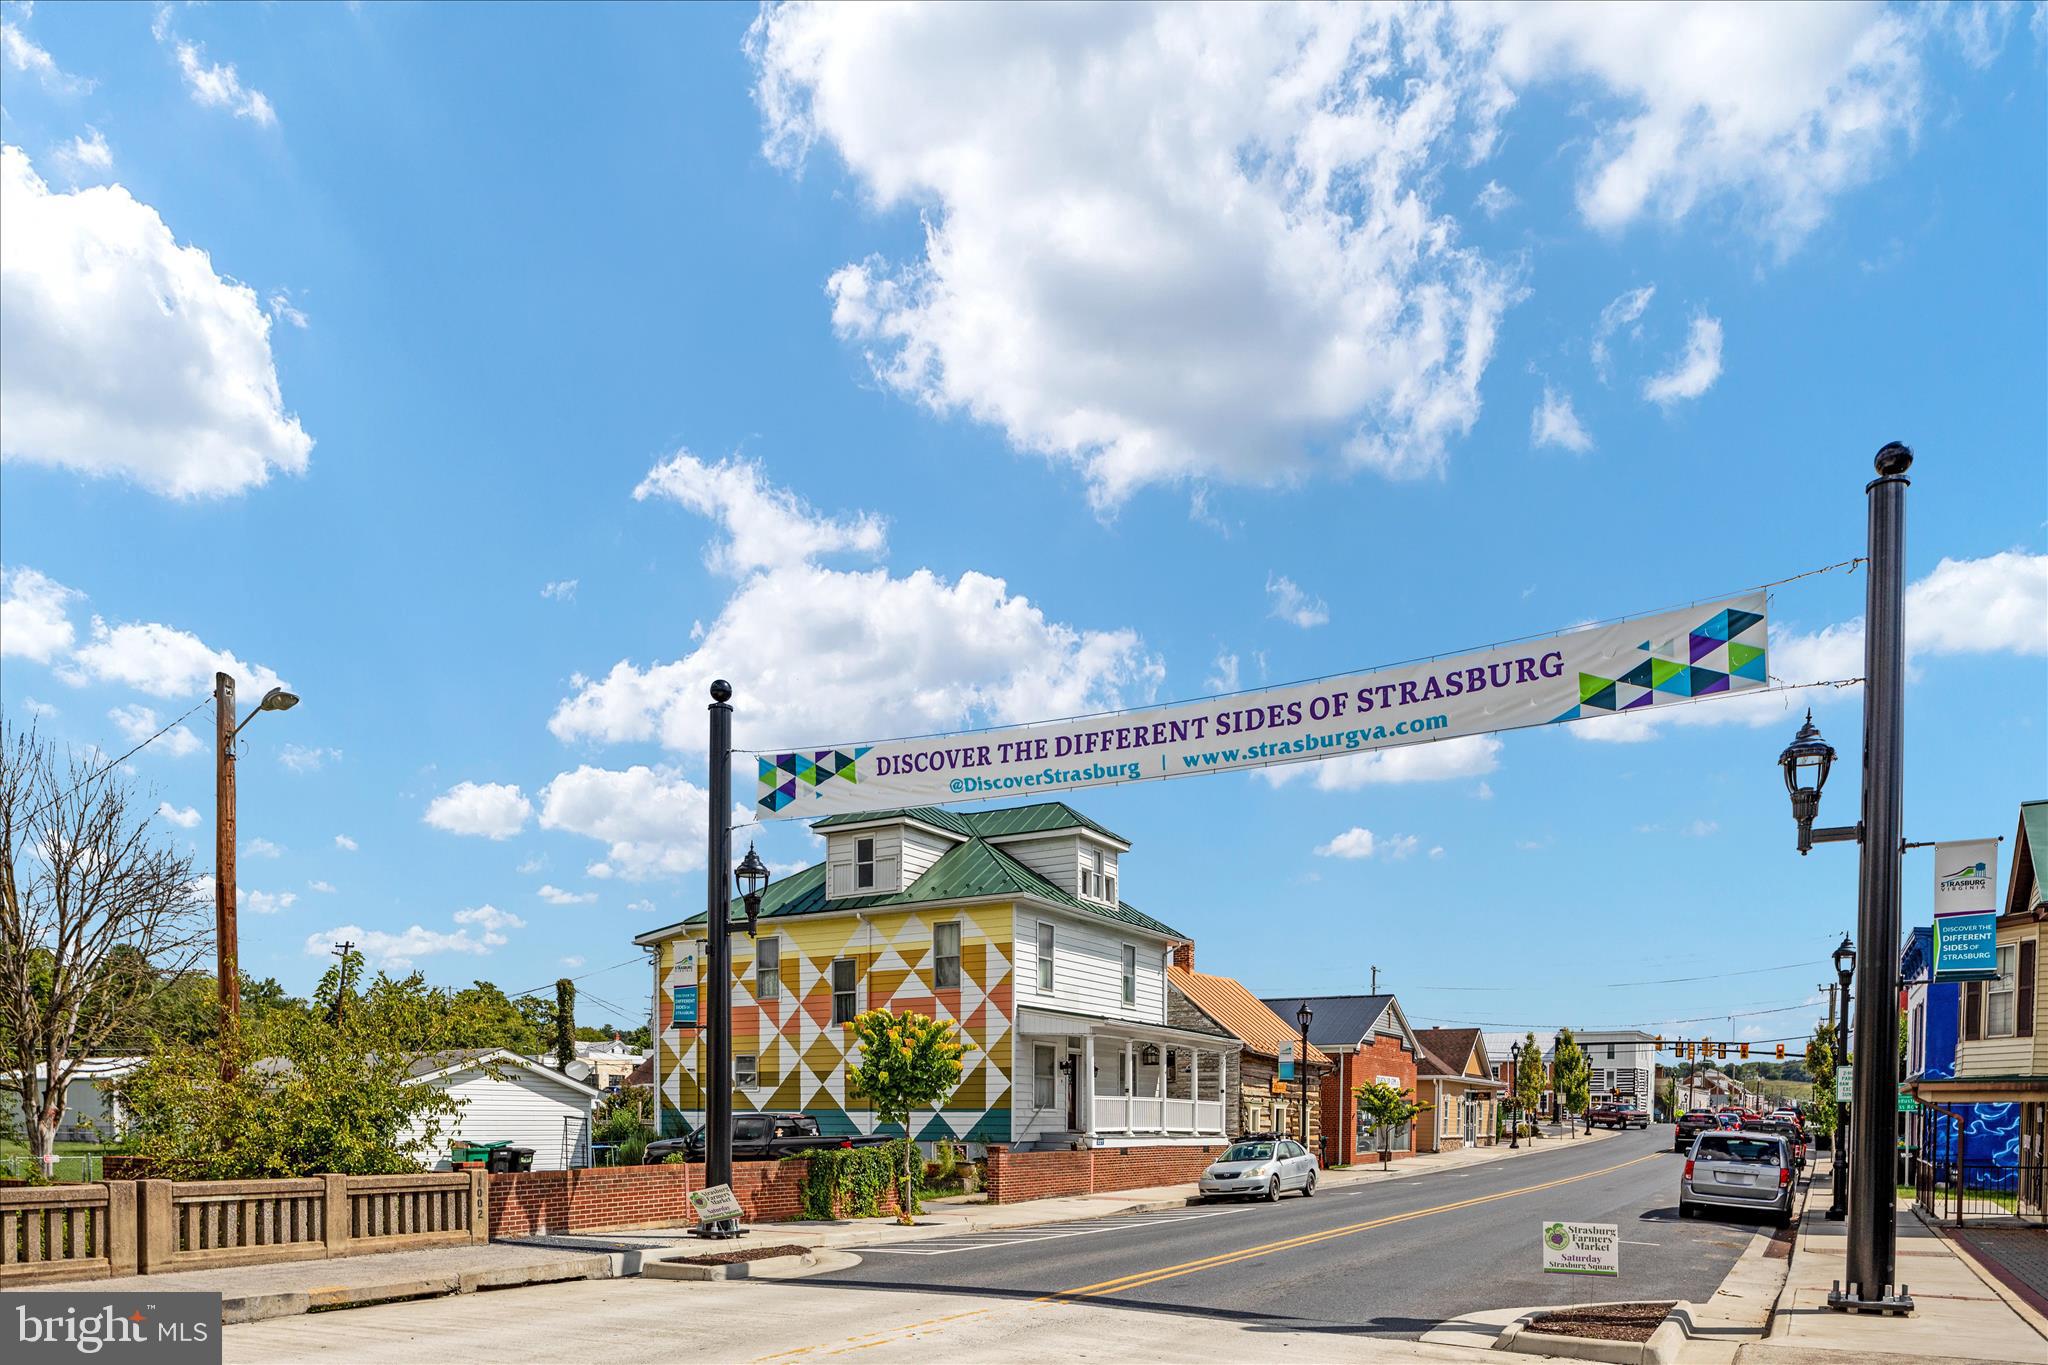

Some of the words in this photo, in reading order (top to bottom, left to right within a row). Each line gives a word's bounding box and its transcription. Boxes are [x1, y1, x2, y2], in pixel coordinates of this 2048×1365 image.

[877, 747, 992, 777] DISCOVER
[999, 741, 1049, 765] THE
[1056, 717, 1210, 758] DIFFERENT
[1216, 703, 1303, 737] SIDES
[1310, 693, 1350, 722] OF
[1358, 651, 1566, 714] STRASBURG
[949, 763, 1142, 794] @DiscoverStrasburg
[1182, 714, 1449, 769] www.strasburgva.com
[1941, 879, 1986, 888] STRASBURG
[1943, 932, 1992, 942] DIFFERENT
[1943, 943, 1968, 952] SIDES
[1943, 952, 1990, 961] STRASBURG
[1568, 1226, 1616, 1237] Strasburg
[1572, 1234, 1612, 1244] Farmers
[1575, 1242, 1609, 1252] Market
[1561, 1254, 1602, 1264] Saturday
[1549, 1261, 1586, 1270] Strasburg
[1587, 1262, 1615, 1271] Square
